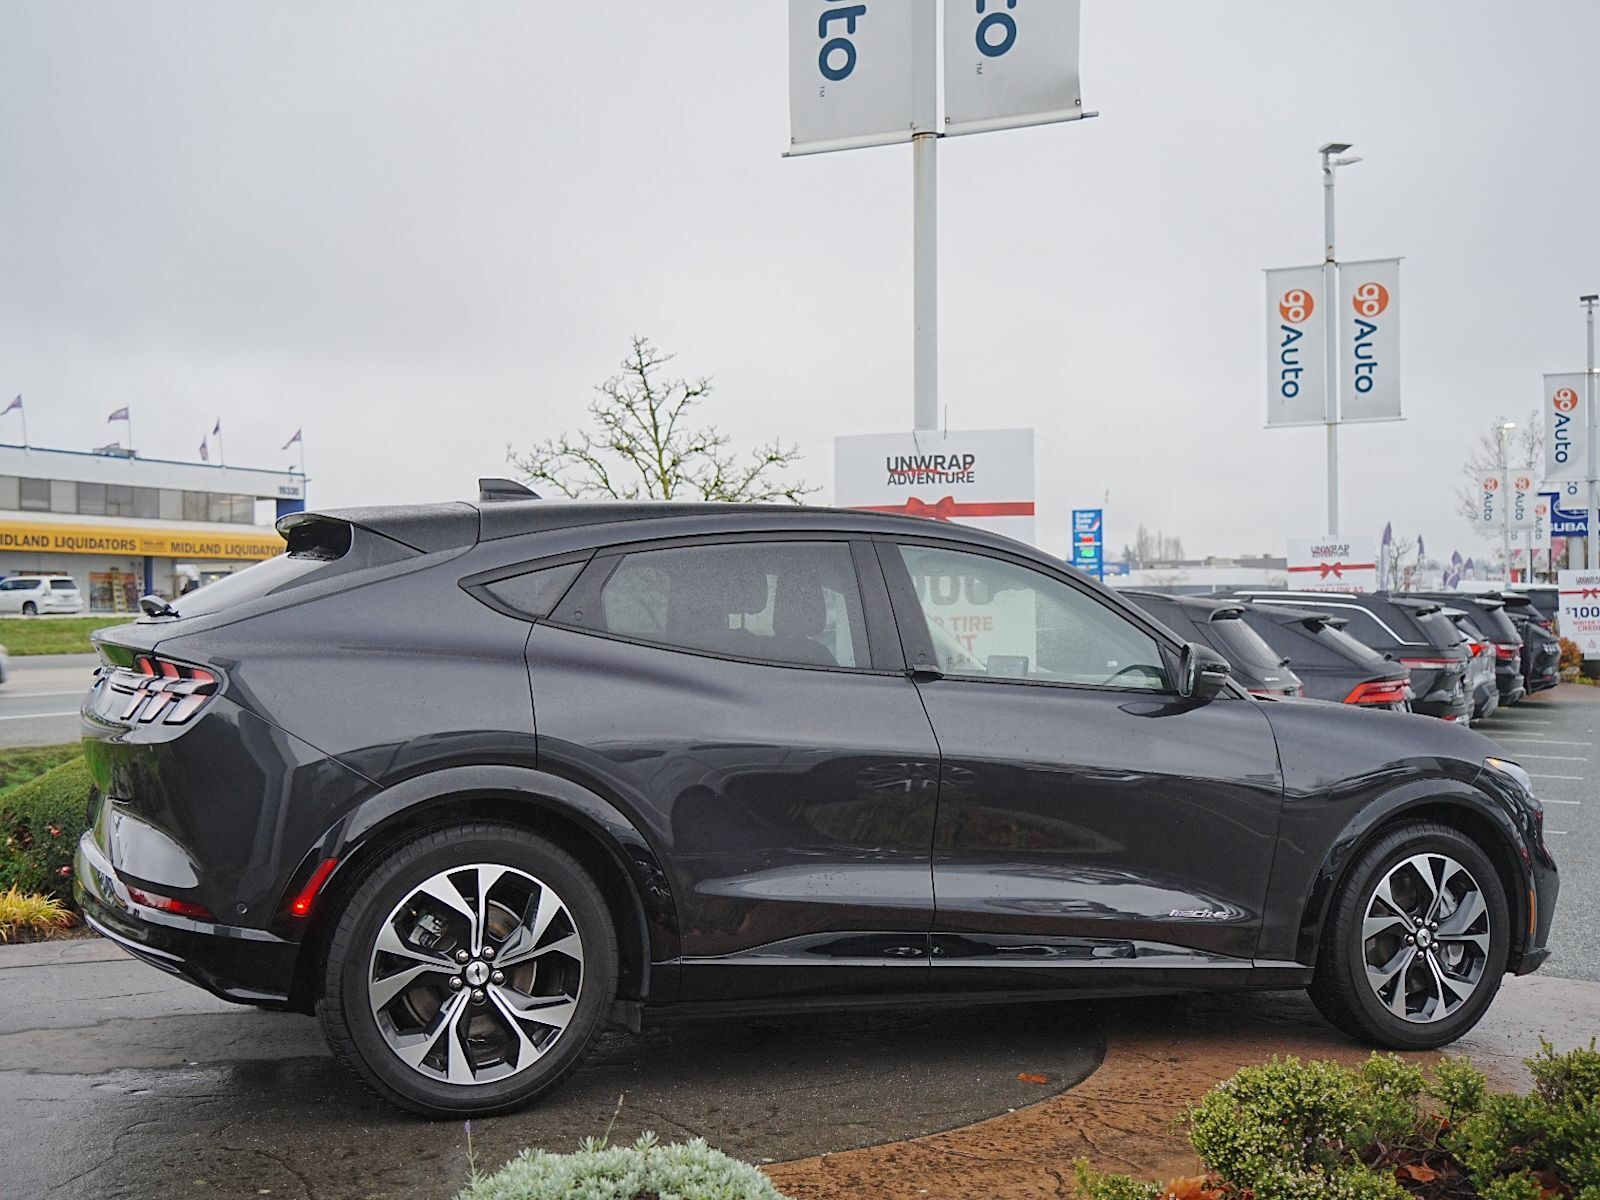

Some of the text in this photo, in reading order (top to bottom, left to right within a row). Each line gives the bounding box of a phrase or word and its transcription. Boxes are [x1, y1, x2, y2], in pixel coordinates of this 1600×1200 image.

[819, 0, 867, 81] to
[1281, 325, 1304, 398] Auto
[1354, 319, 1378, 393] Auto
[1554, 412, 1571, 463] Auto
[887, 454, 975, 473] UNWRAP
[887, 471, 975, 486] ADVENTURE
[1483, 491, 1493, 521] Auto
[1515, 491, 1525, 521] Auto
[1551, 522, 1588, 532] UBA
[55, 537, 136, 550] LIQUIDATORS
[171, 542, 221, 554] MIDLAND
[1311, 545, 1350, 553] UNWRAP
[950, 616, 993, 633] TIRE
